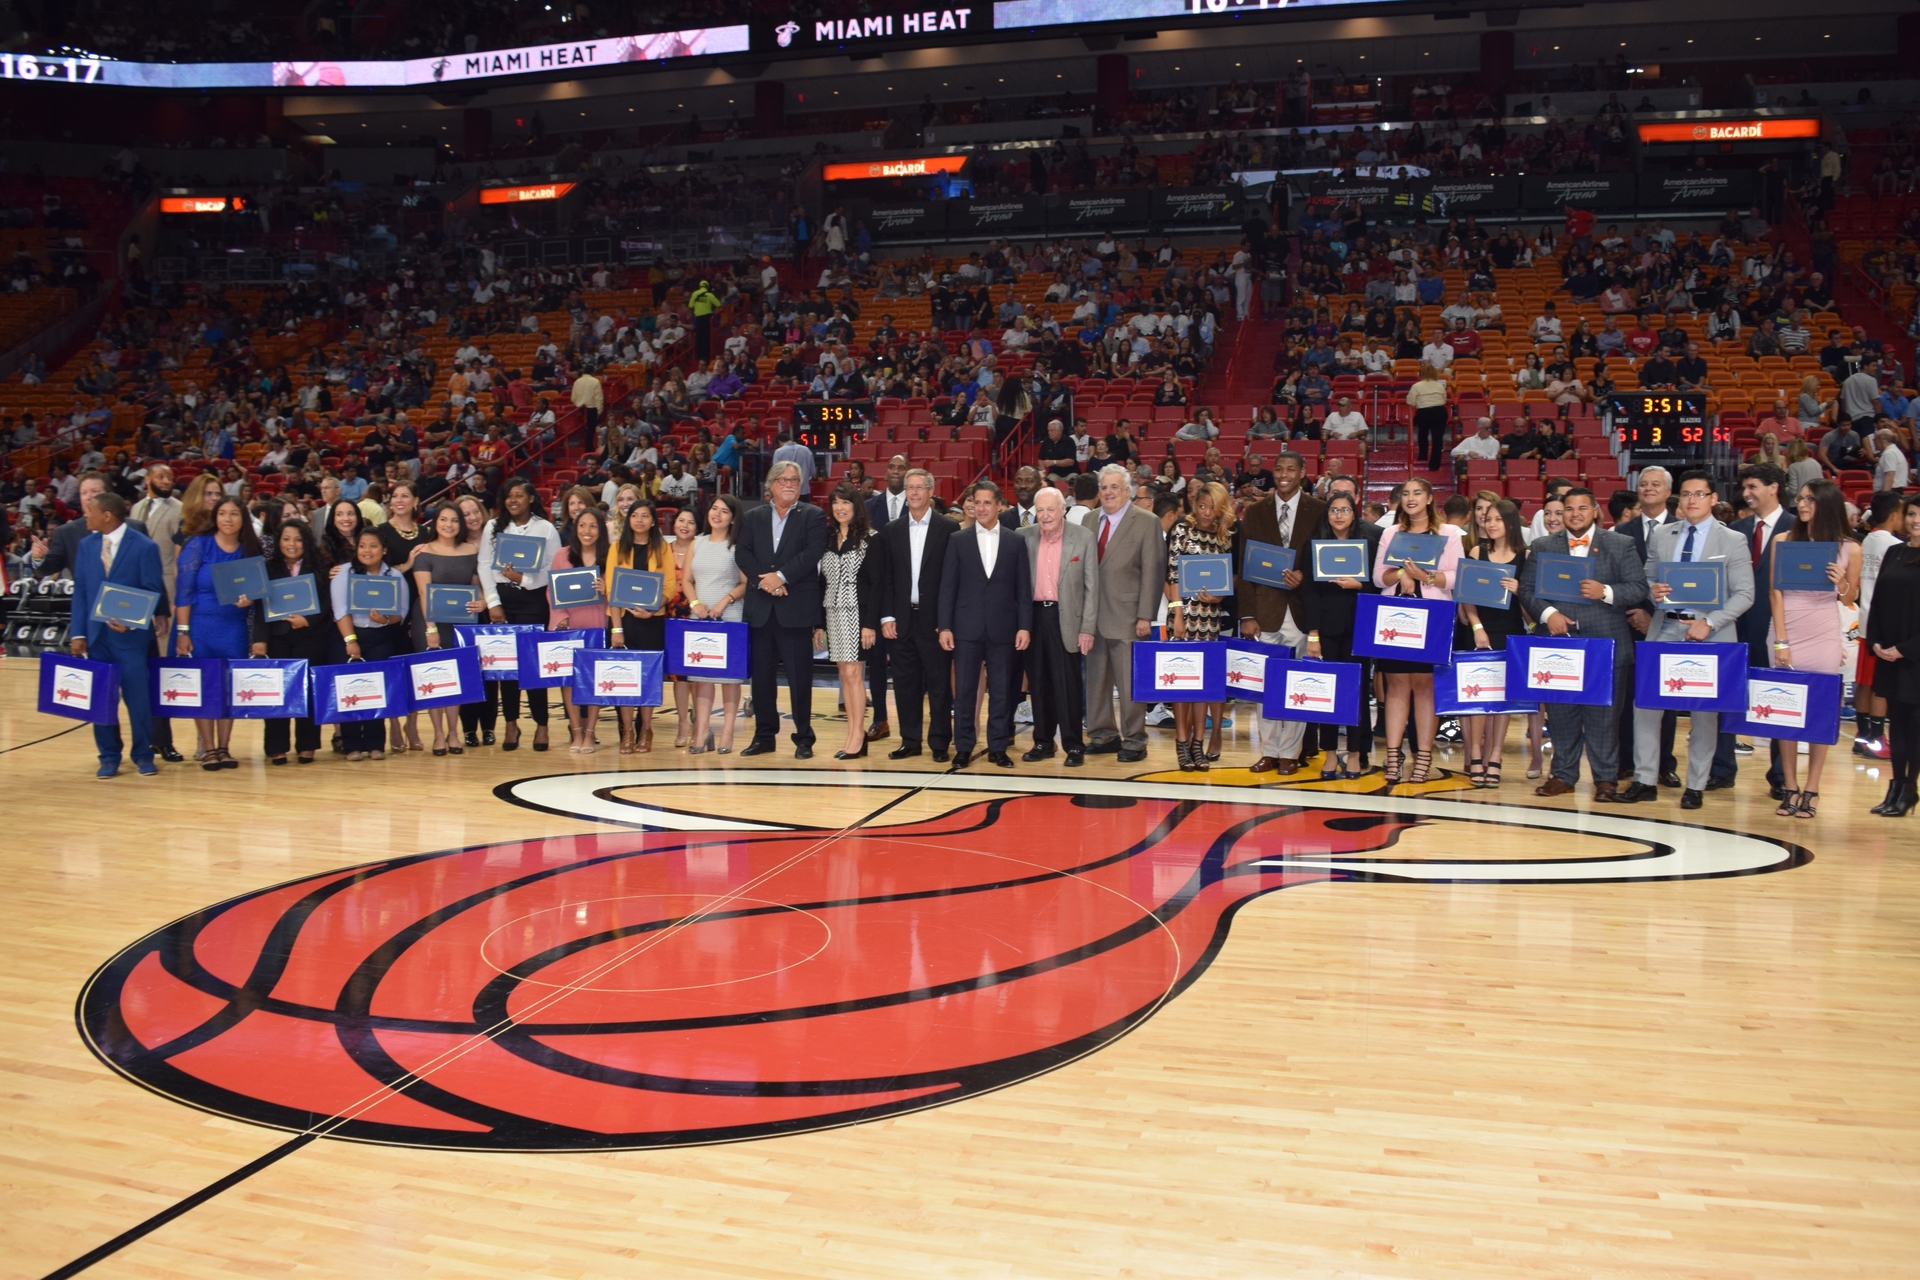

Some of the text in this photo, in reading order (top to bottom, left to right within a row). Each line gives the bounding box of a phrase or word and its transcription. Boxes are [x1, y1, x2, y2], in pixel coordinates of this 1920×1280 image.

[815, 8, 971, 41] MIAMI HEAT
[465, 45, 598, 75] MIAMI HEAT
[0, 53, 100, 83] 16 17
[1710, 122, 1762, 138] BACARDÍ
[882, 160, 925, 176] BACARDÍ
[519, 185, 556, 200] BACARDÍ
[1553, 188, 1597, 205] Arena
[1670, 186, 1716, 202] Arena
[1076, 206, 1114, 221] Arena
[1644, 398, 1682, 413] 3:51
[822, 407, 852, 420] 3:51
[800, 433, 818, 446] 51
[829, 433, 836, 446] 3
[1617, 427, 1638, 442] 51
[1652, 427, 1661, 442] 3
[1682, 427, 1704, 442] 52
[17, 625, 31, 639] G
[43, 626, 58, 640] G
[1757, 693, 1794, 701] CARNIVAL
